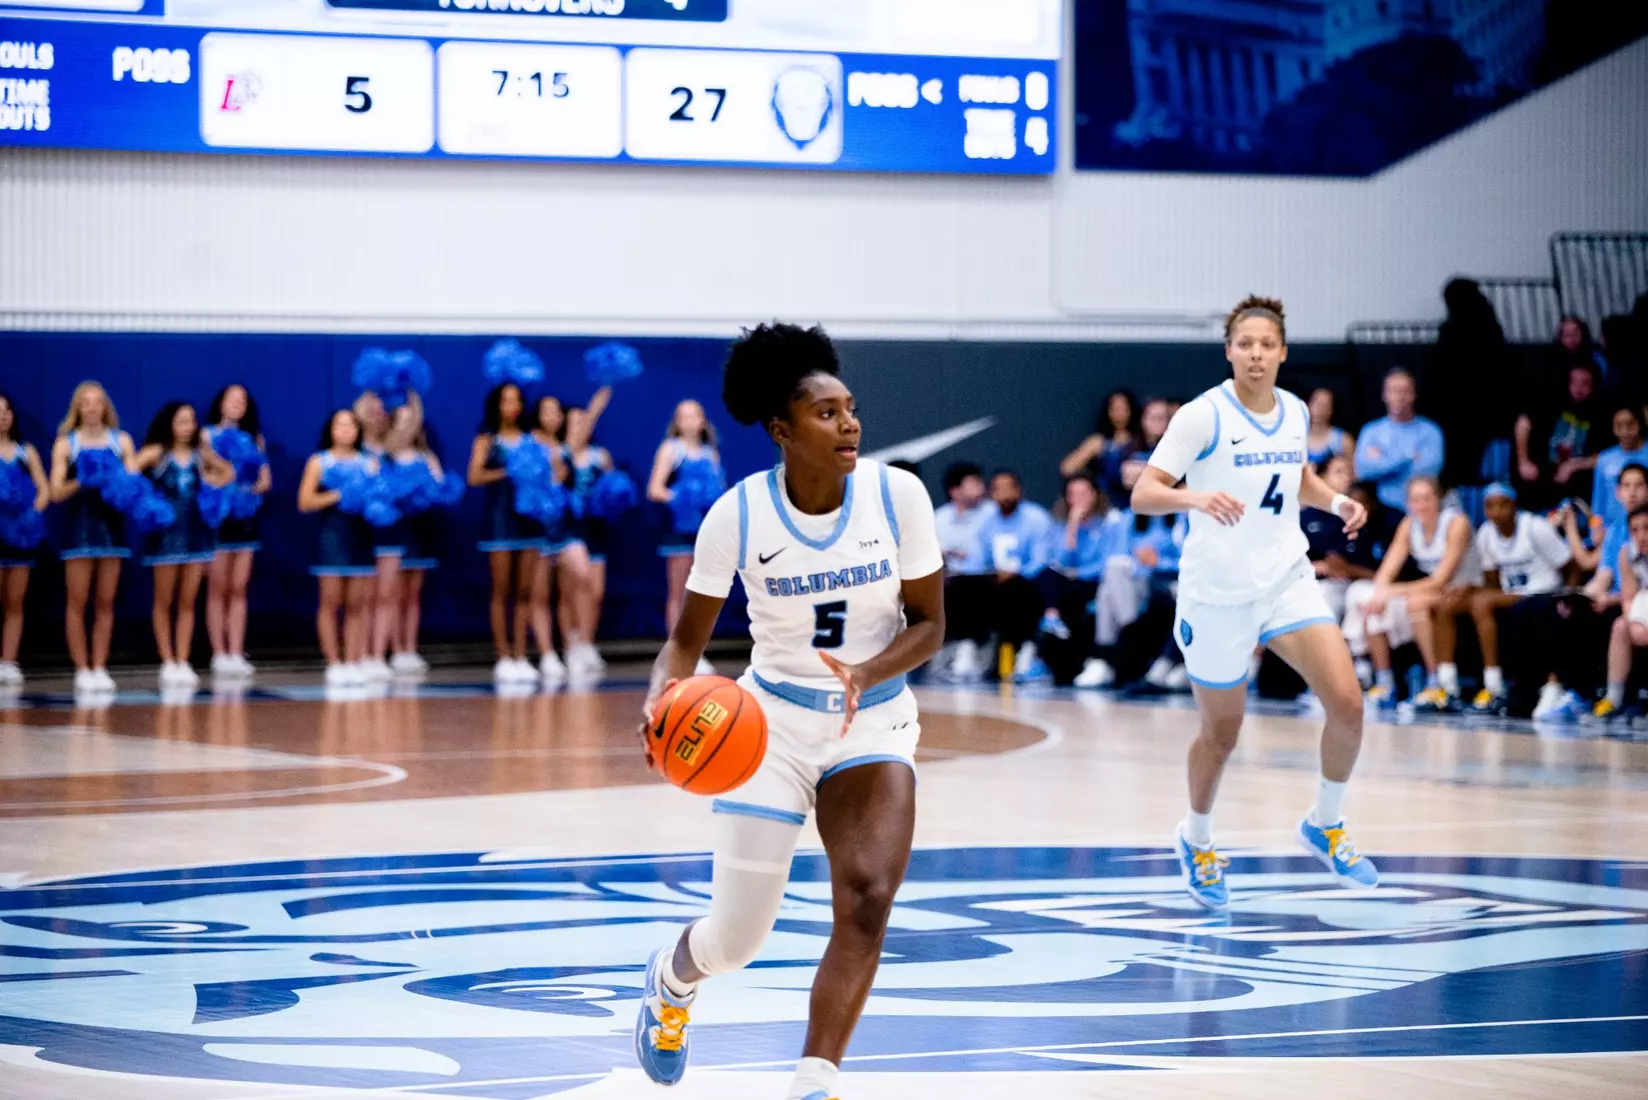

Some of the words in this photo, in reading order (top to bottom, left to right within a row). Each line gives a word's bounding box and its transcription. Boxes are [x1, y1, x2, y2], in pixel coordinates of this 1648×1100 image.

[112, 46, 191, 84] POSS
[492, 70, 570, 98] 7:15
[344, 76, 372, 113] 5
[669, 87, 727, 122] 27
[1259, 473, 1284, 515] 4
[764, 559, 892, 597] COLUMBIA
[811, 600, 848, 649] 5
[674, 701, 722, 761] ELITE
